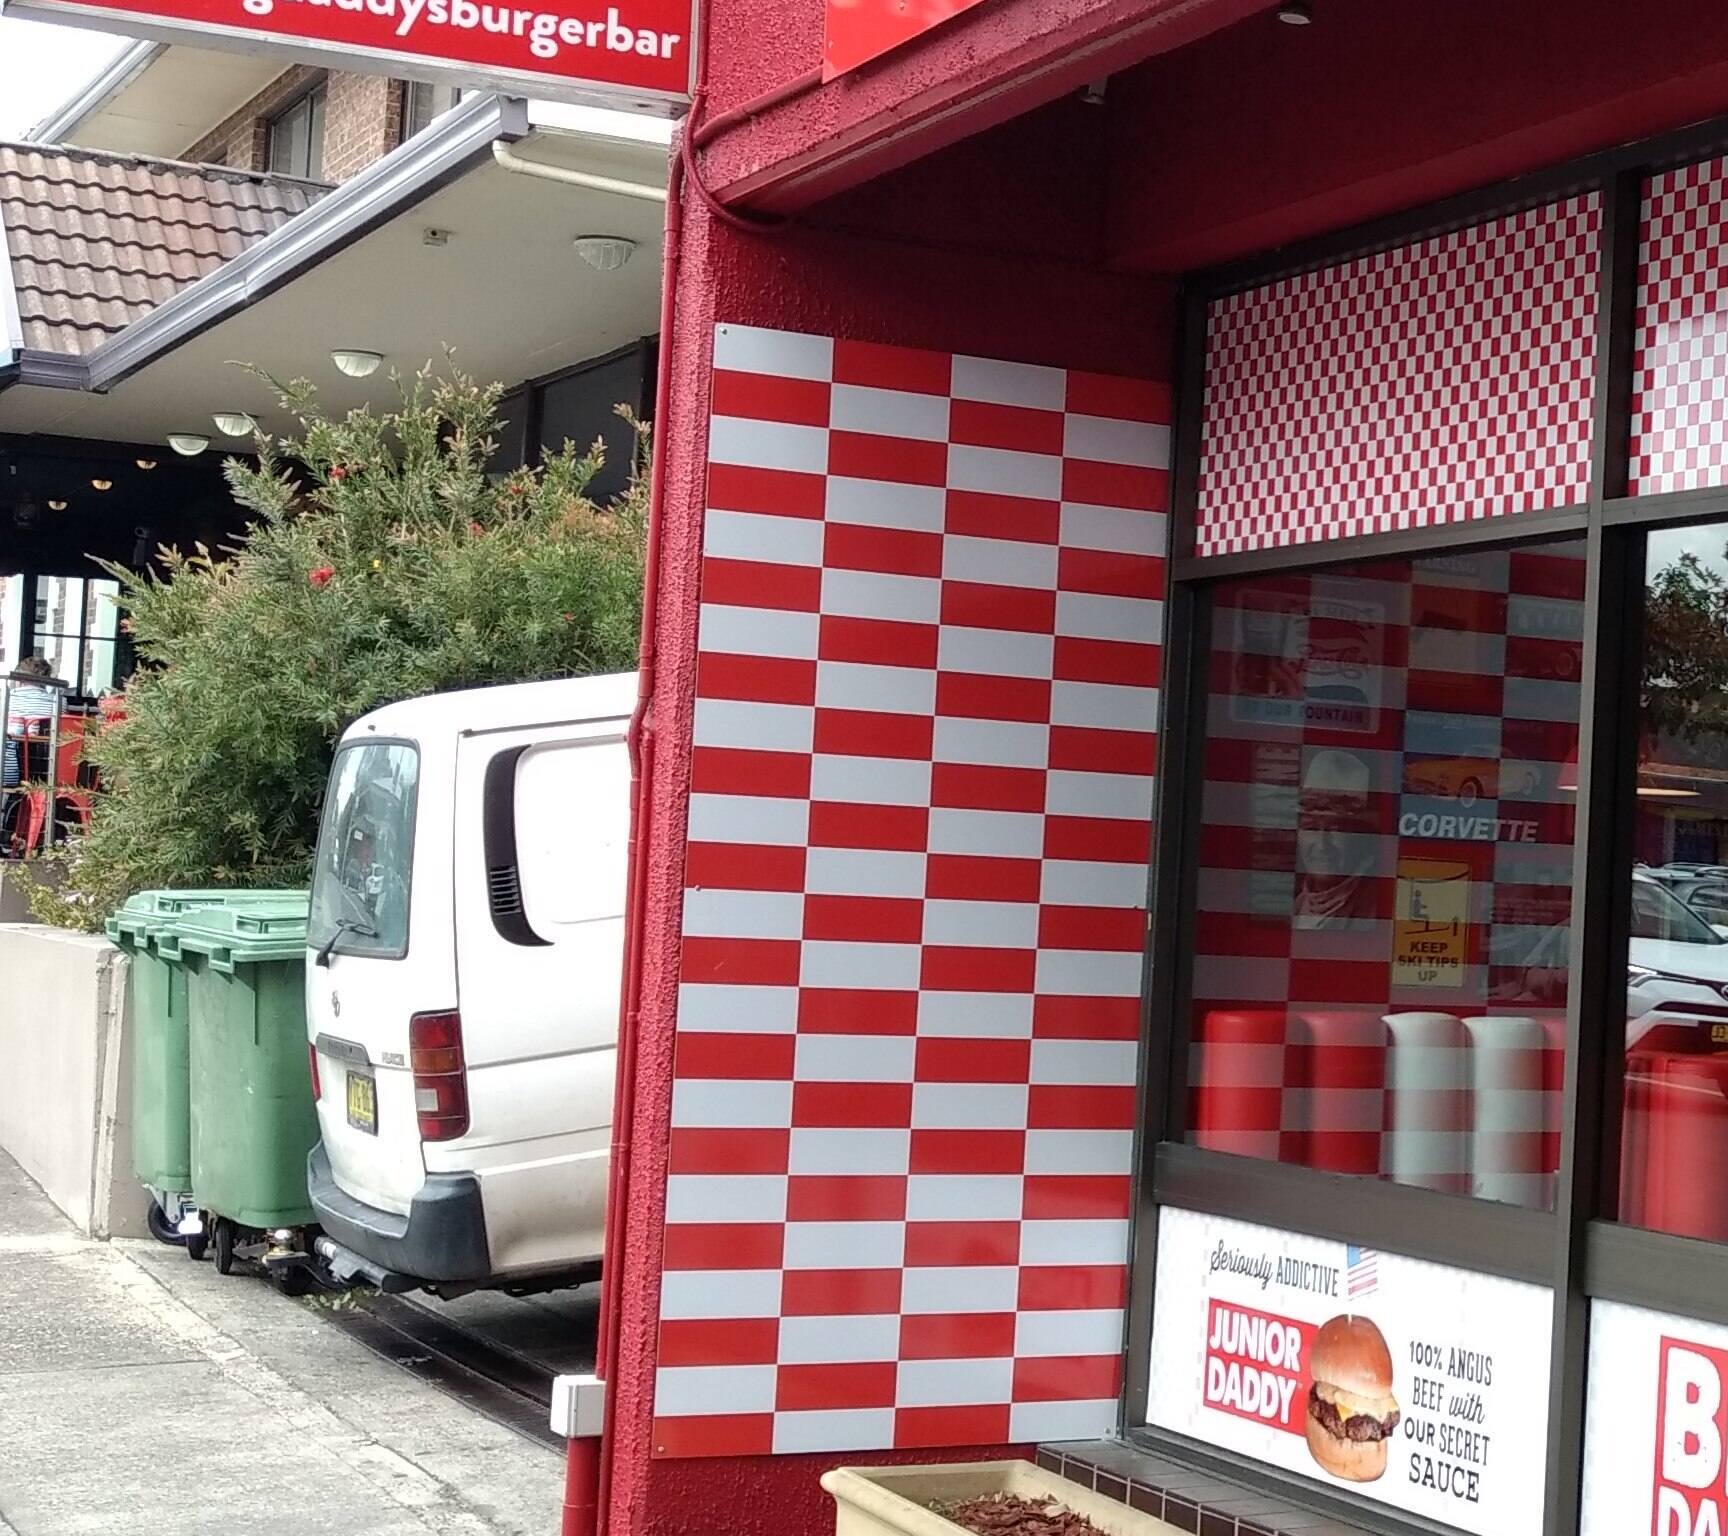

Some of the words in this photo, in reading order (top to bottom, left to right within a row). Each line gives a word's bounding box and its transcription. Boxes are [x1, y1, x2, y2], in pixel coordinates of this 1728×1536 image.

[1399, 810, 1540, 843] CORVETTE
[1398, 954, 1423, 968] SKI
[1426, 955, 1459, 969] TIPS
[1409, 940, 1449, 954] KEEP
[1417, 969, 1437, 982] UP
[1208, 1239, 1274, 1291] Seriously
[1275, 1255, 1340, 1298] ADDICTIVE
[1209, 1306, 1302, 1374] JUNIOR
[1409, 1340, 1443, 1372] 100%
[1447, 1346, 1493, 1386] ANGUS
[1207, 1355, 1298, 1424] DADDY
[1411, 1375, 1445, 1413] BEEF
[1448, 1390, 1486, 1425] with
[1403, 1415, 1436, 1448] OUR
[1438, 1422, 1491, 1467] SECRET
[1408, 1452, 1480, 1504] SAUCE
